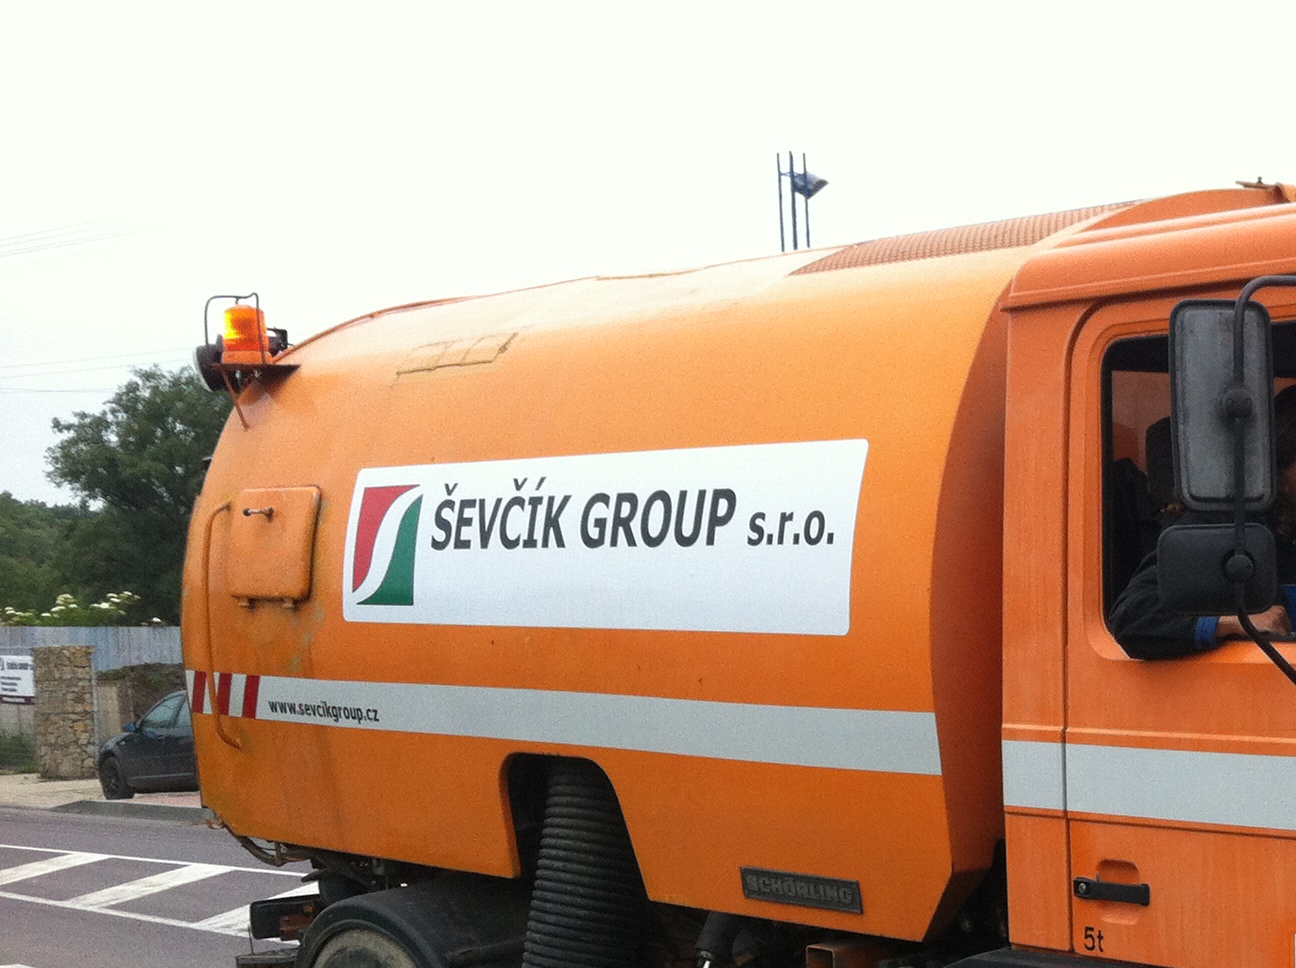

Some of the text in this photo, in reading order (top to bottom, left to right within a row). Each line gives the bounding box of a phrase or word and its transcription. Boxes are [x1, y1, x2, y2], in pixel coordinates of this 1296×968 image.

[430, 476, 835, 551] ŠEVČÍK GROUP s.r.o.
[1083, 925, 1105, 953] 5t
